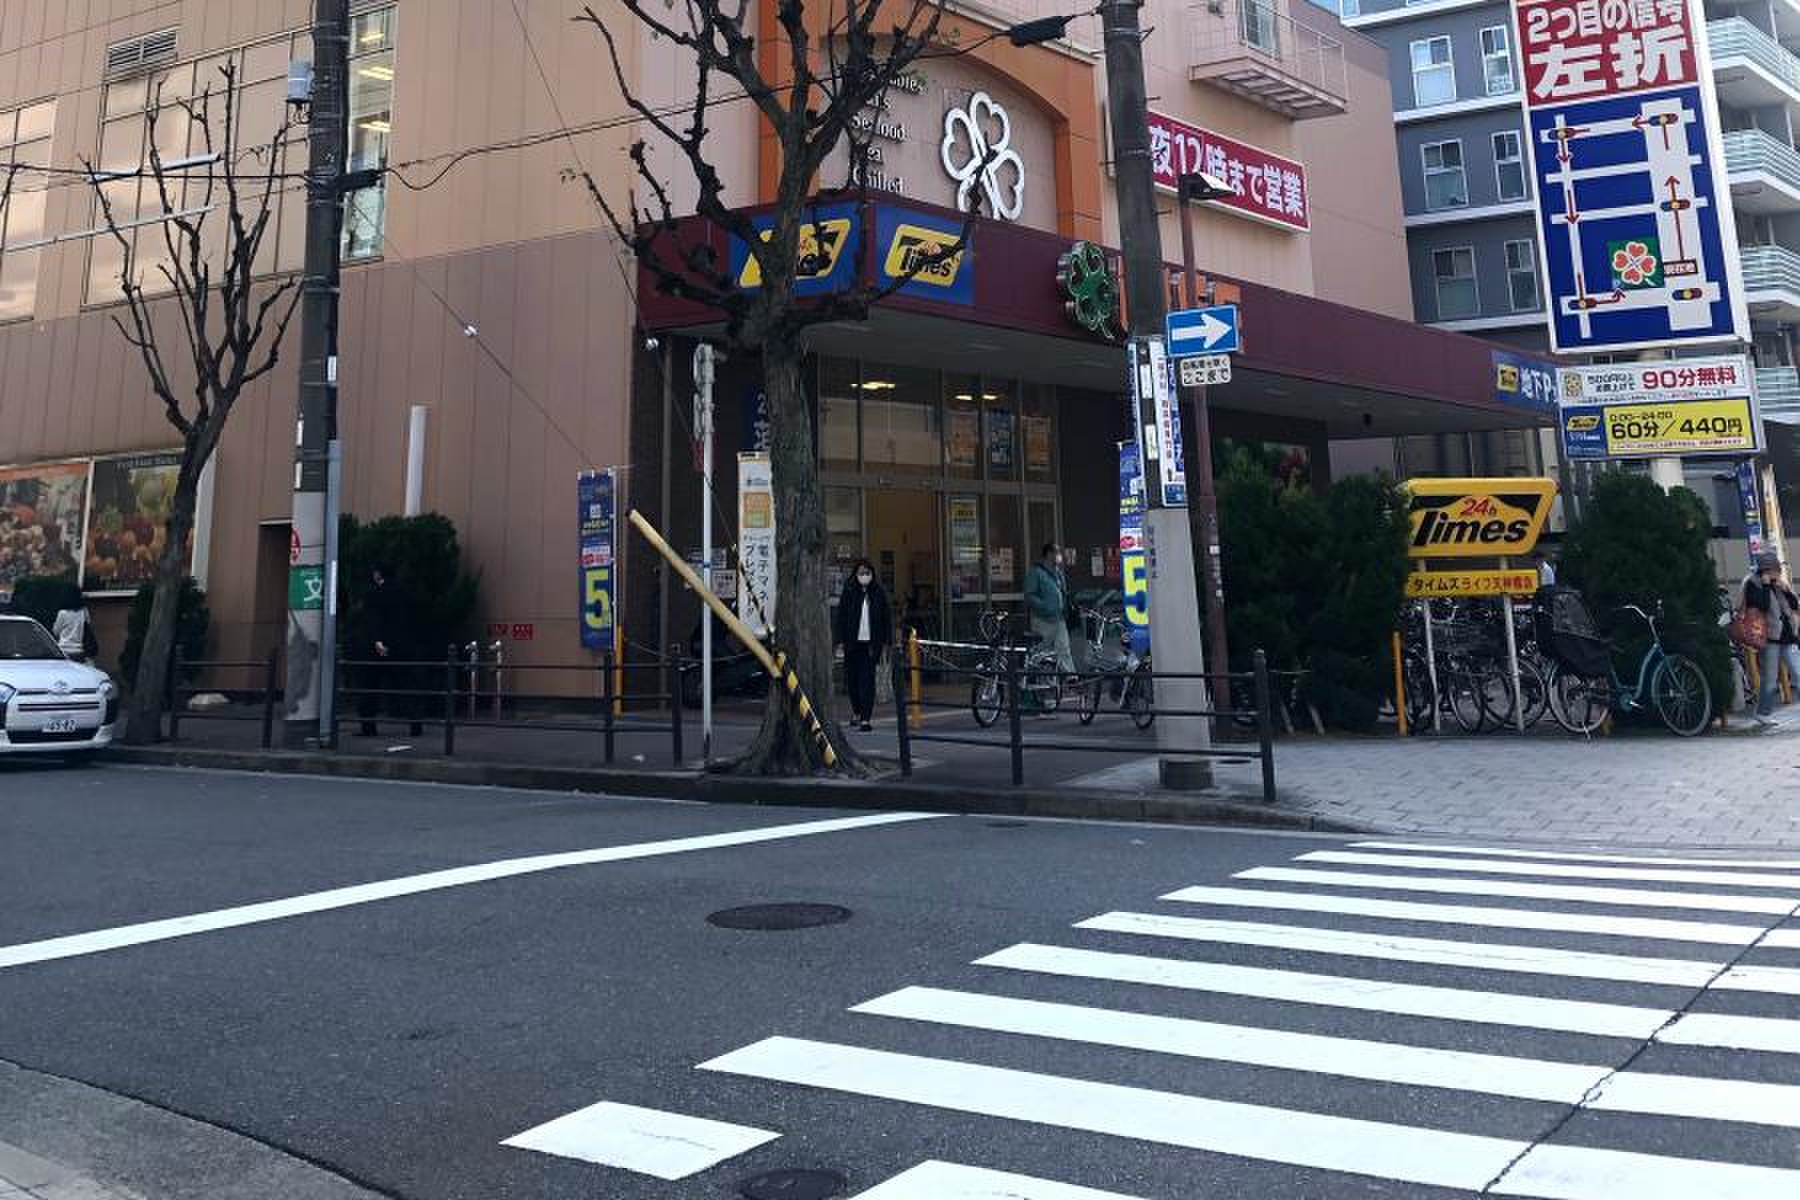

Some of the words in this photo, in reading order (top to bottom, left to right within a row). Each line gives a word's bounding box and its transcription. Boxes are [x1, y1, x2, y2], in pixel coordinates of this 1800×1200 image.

[1529, 26, 1688, 100] 左折
[1641, 365, 1737, 390] 90分無料
[1412, 510, 1531, 547] Times
